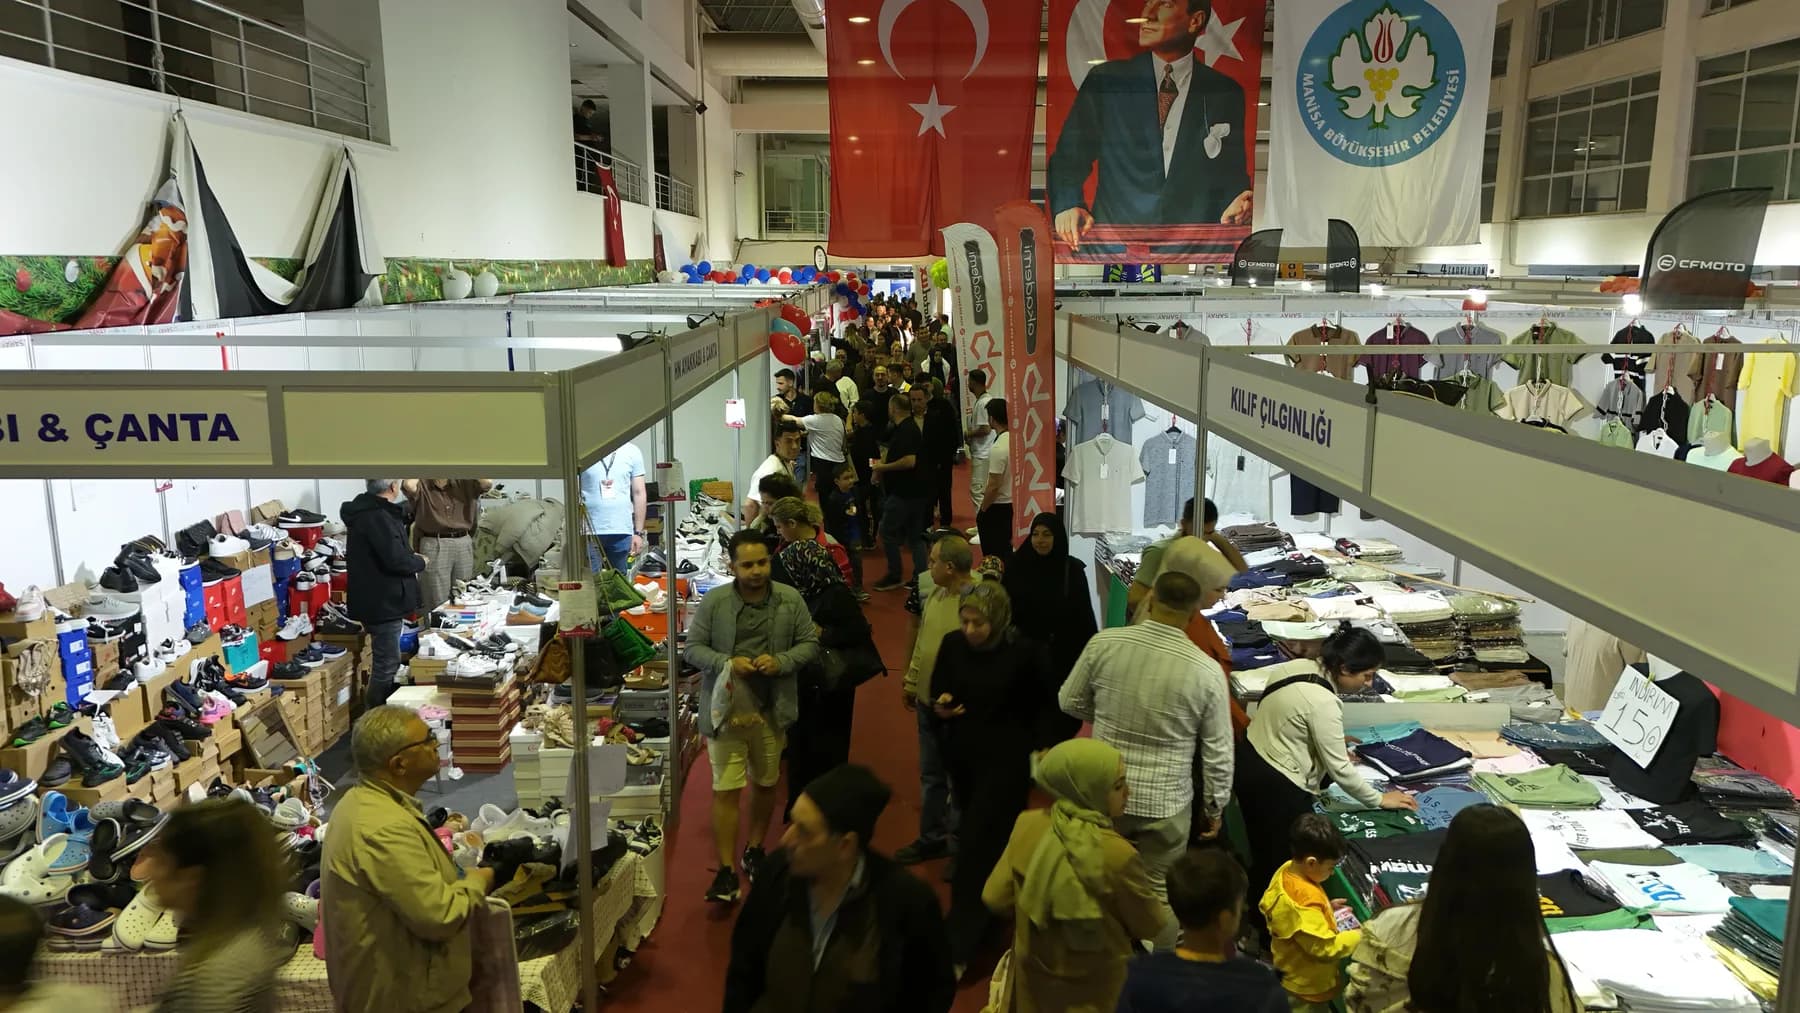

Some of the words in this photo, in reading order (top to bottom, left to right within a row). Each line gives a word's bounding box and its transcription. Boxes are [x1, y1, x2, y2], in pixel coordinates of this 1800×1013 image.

[1302, 72, 1326, 131] MANİSA
[1323, 128, 1411, 161] BÜYÜKŞEHİR
[1412, 68, 1460, 145] BELEDİYESİ
[1679, 259, 1746, 272] CFMOTO
[38, 413, 69, 442] &
[85, 413, 241, 450] ÇANTA
[1230, 386, 1257, 418] KILIF
[1260, 396, 1332, 448] ÇILGINLIĞI
[1603, 702, 1662, 753] 150
